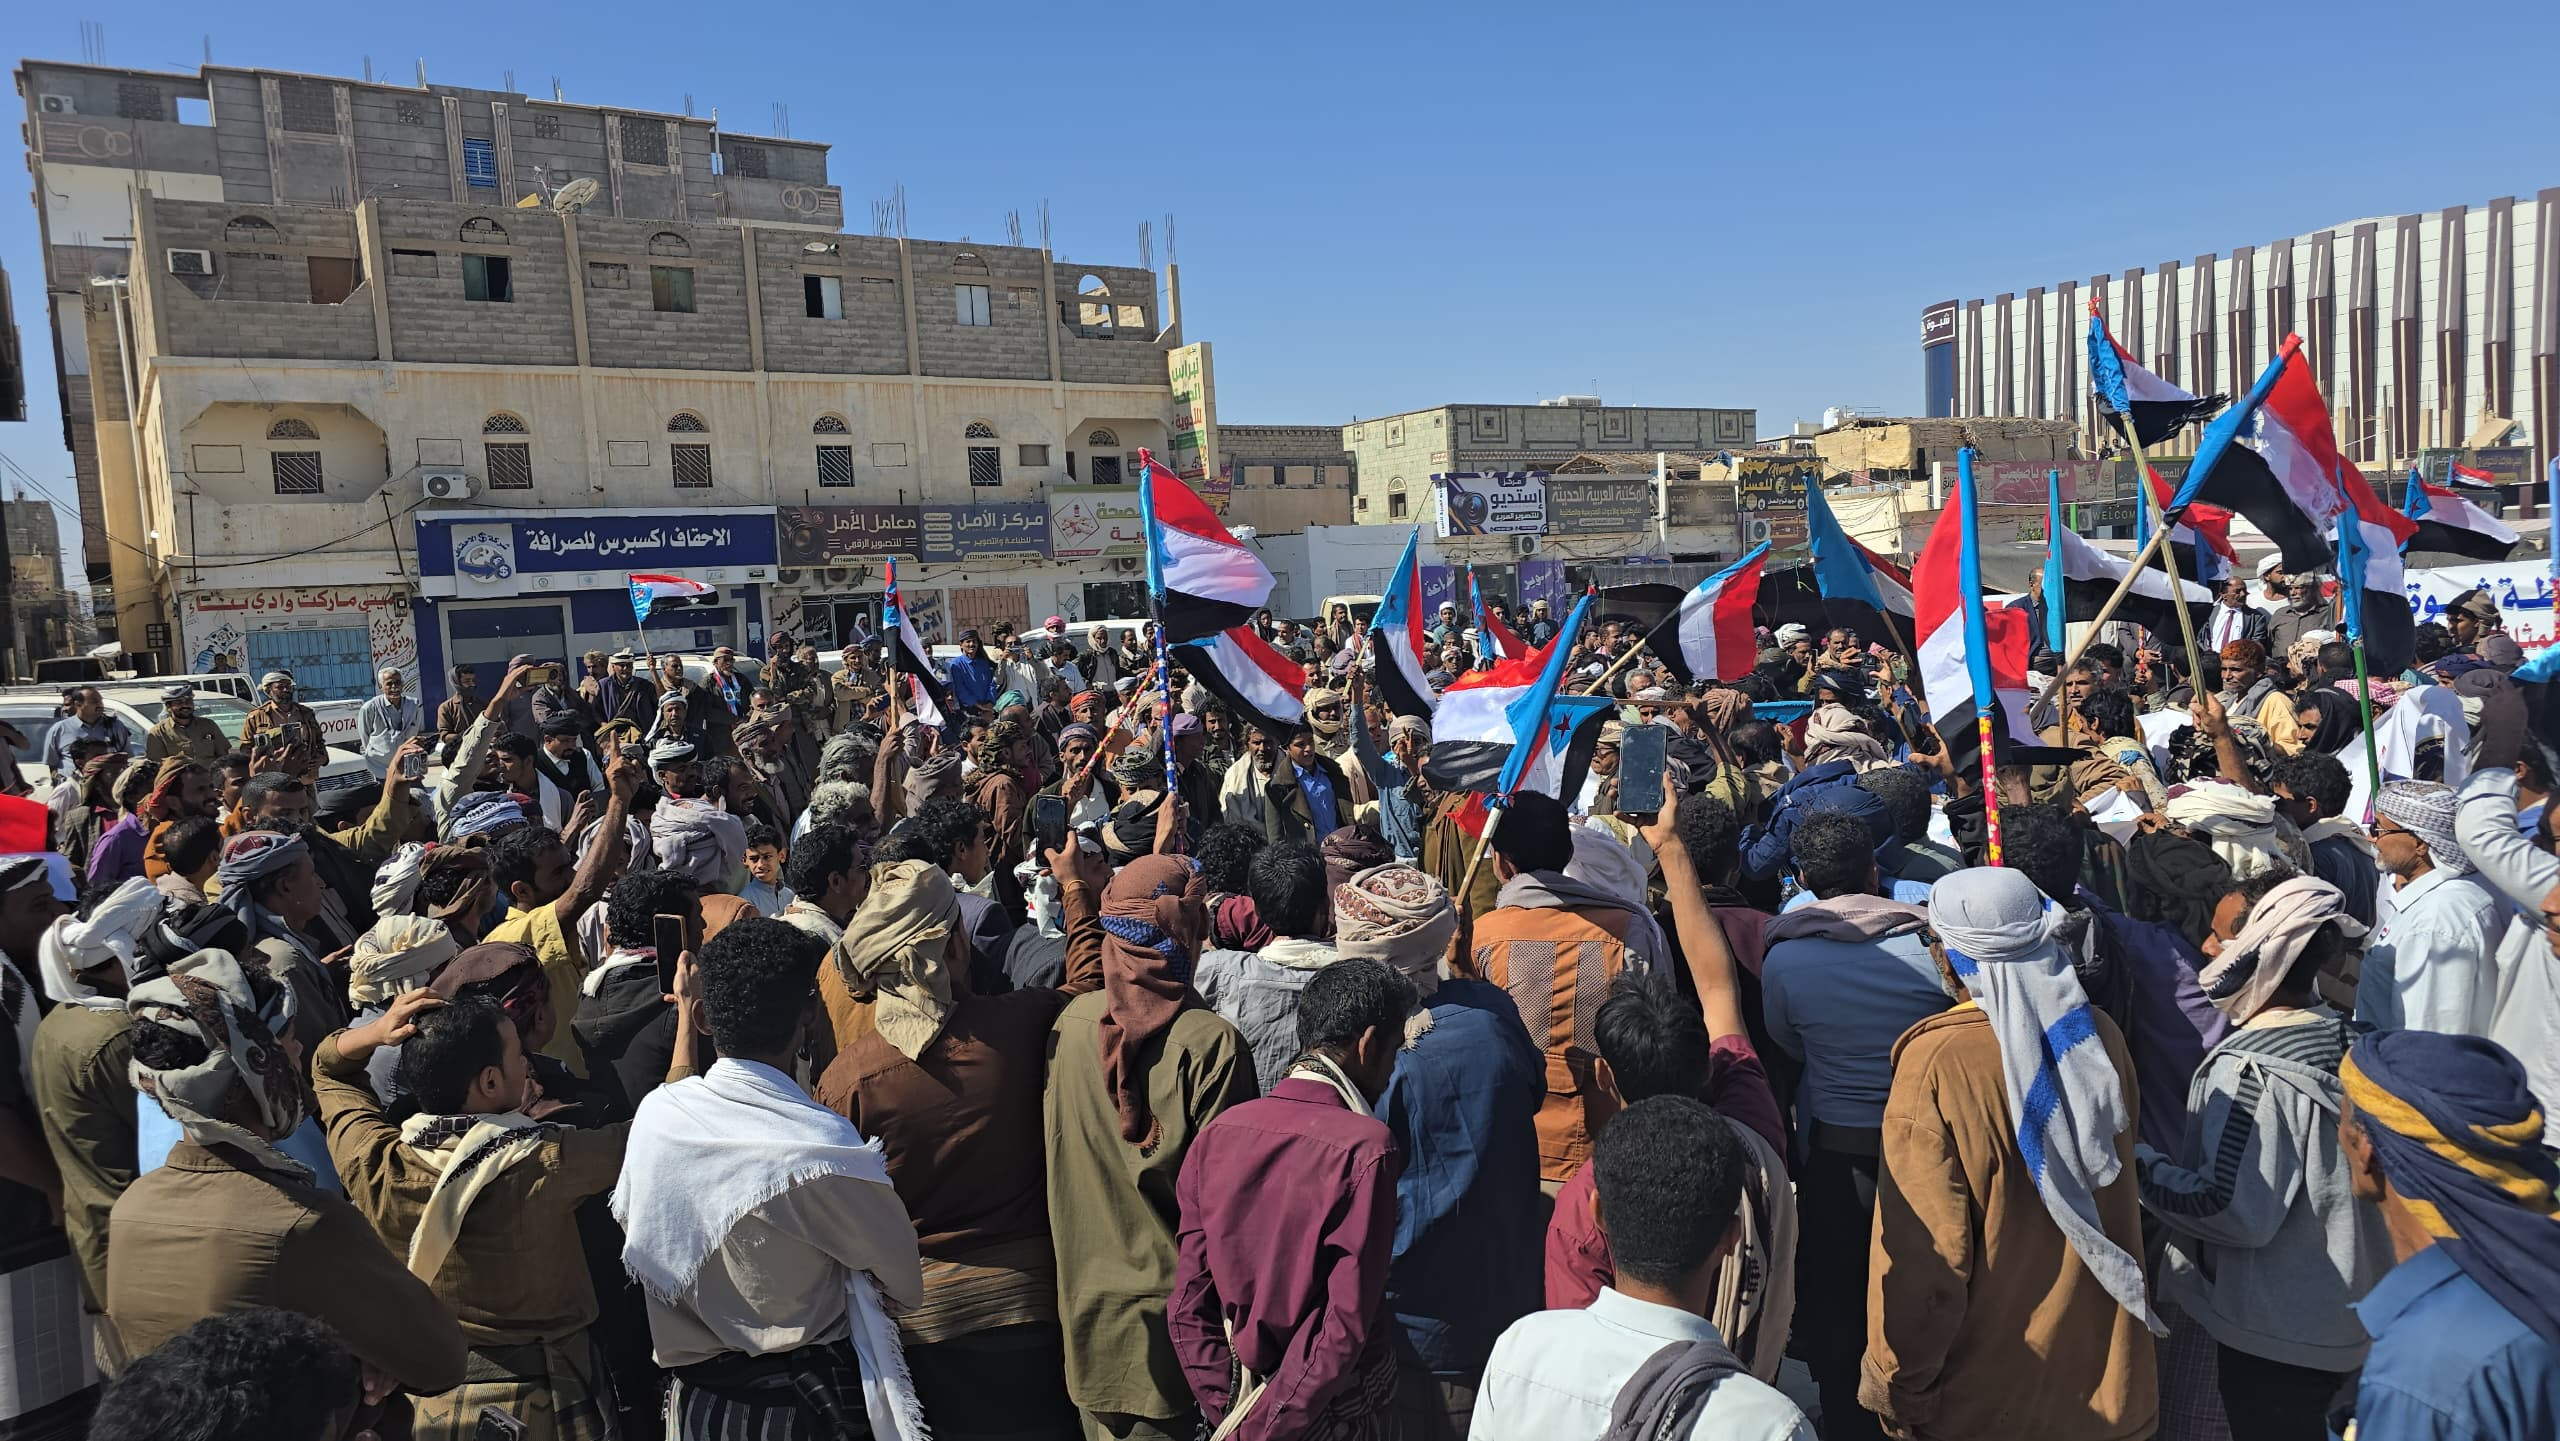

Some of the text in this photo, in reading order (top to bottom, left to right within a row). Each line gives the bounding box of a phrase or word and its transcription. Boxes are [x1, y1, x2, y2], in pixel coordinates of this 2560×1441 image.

[1926, 312, 1951, 332] شبوة
[1490, 488, 1544, 510] إستديو
[1551, 483, 1585, 507] الحديثة
[1615, 484, 1647, 505] المكتبة
[826, 508, 917, 534] معامل الأمل
[1001, 513, 1044, 531] مركز
[2093, 511, 2136, 521] WELCOM
[526, 526, 731, 557] الاحقاف اكسبرس للصرافة
[871, 537, 902, 550] للتصوير
[251, 592, 294, 614] وادي
[297, 590, 357, 612] ماركت
[319, 718, 358, 734] OYOTA
